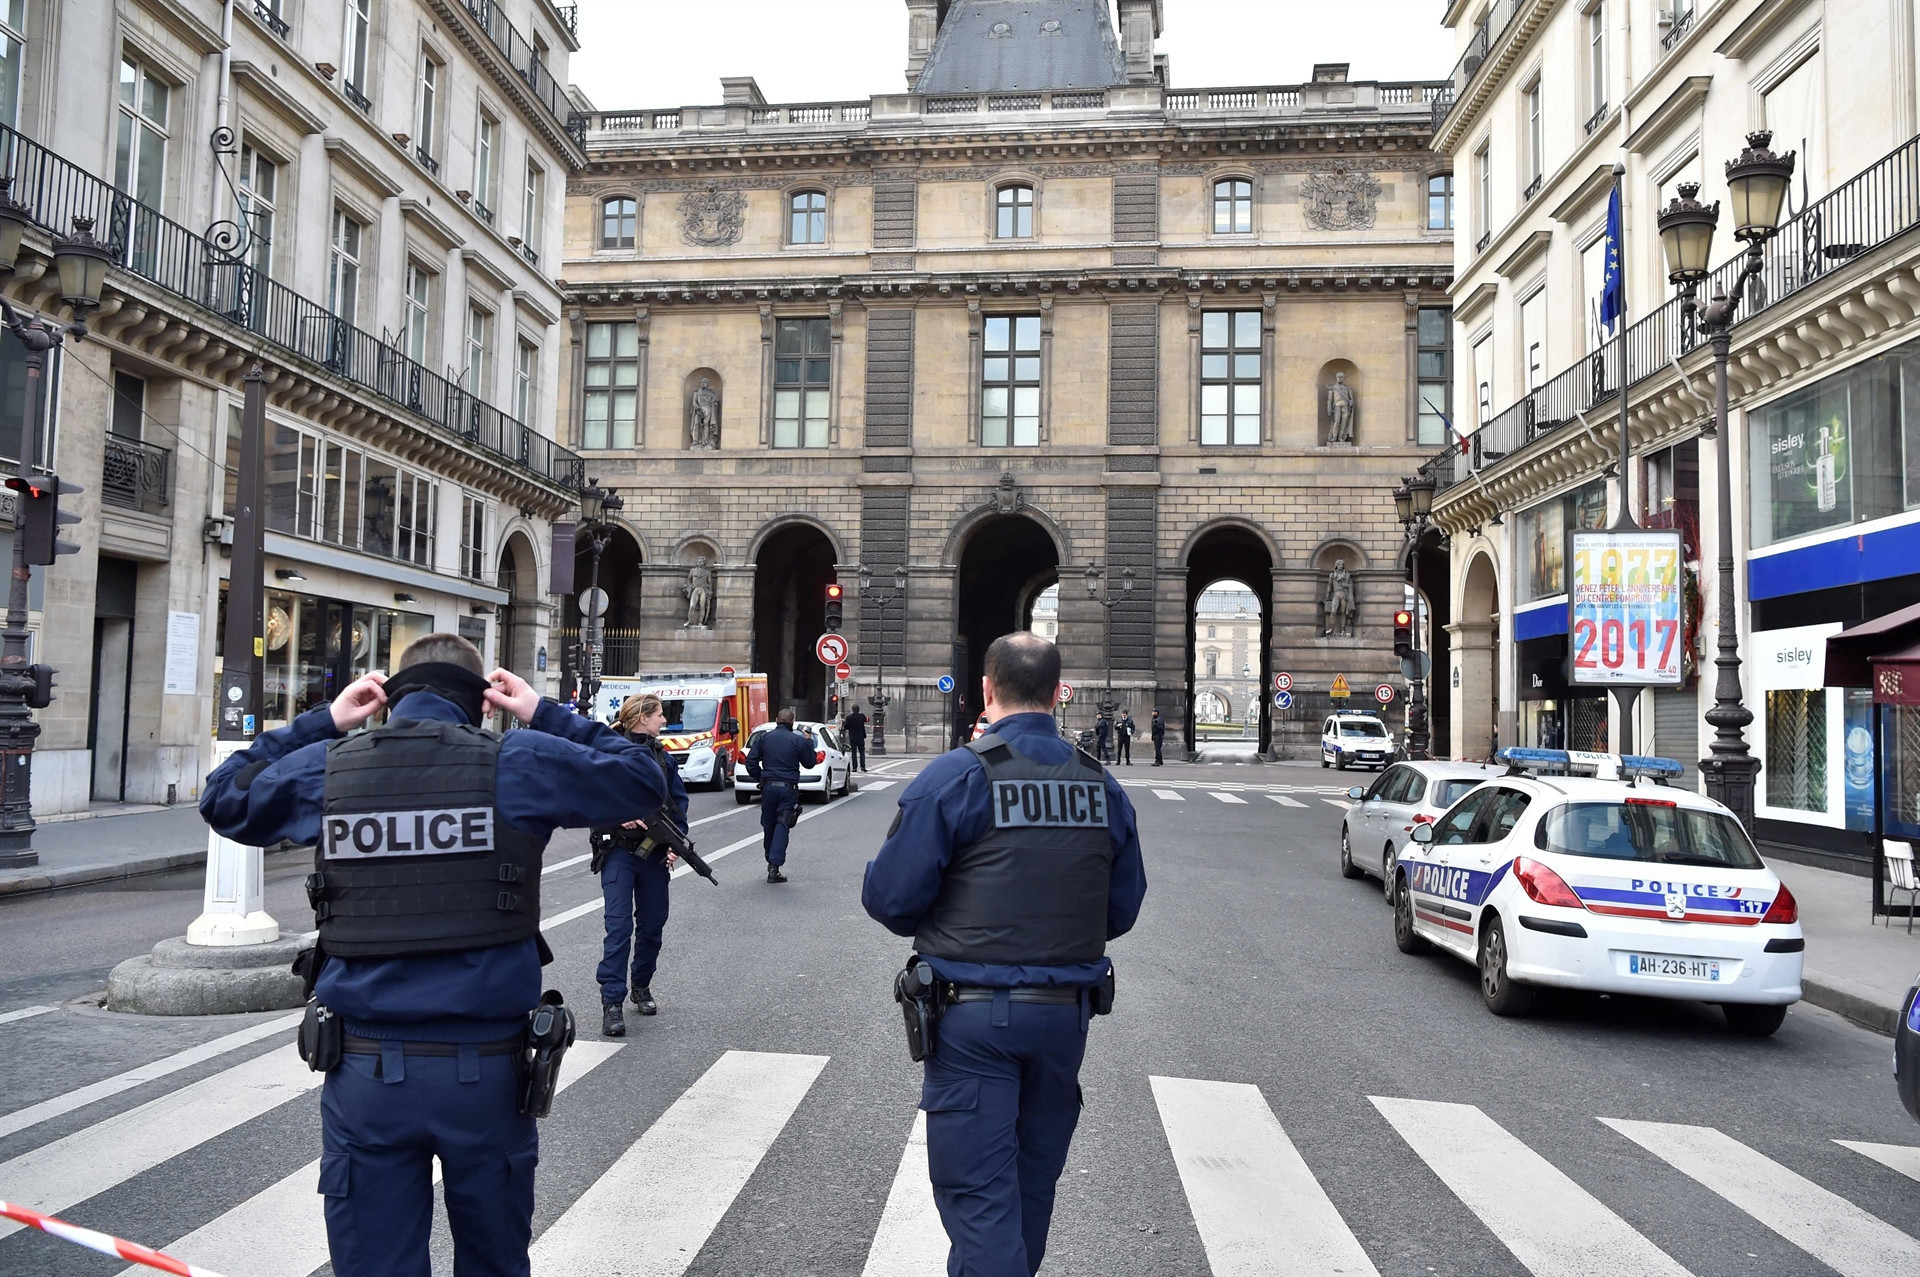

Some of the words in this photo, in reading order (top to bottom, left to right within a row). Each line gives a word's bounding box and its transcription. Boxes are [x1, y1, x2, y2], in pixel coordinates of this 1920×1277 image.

[1771, 433, 1804, 454] sisley
[950, 459, 1000, 470] PAVILLON
[1007, 459, 1023, 470] DE
[1029, 459, 1067, 470] ROHAN
[1575, 549, 1677, 602] 1977
[1576, 584, 1597, 593] VENEZ
[1576, 594, 1585, 602] DU
[1587, 594, 1613, 602] CENTRE
[1616, 594, 1651, 603] POMPIDOU
[1575, 619, 1678, 669] 2017
[1776, 647, 1812, 664] sisley
[1668, 665, 1677, 673] 40
[1279, 678, 1289, 686] 15
[1532, 673, 1543, 687] Dior
[1380, 690, 1390, 698] 15
[1576, 752, 1612, 760] POLICE
[998, 783, 1103, 823] POLICE
[327, 812, 488, 854] POLICE
[1424, 866, 1470, 900] POLICE
[1632, 879, 1718, 897] POLICE
[1745, 902, 1762, 914] 17
[1640, 957, 1708, 977] AH-236-HT
[1711, 971, 1718, 980] 75
